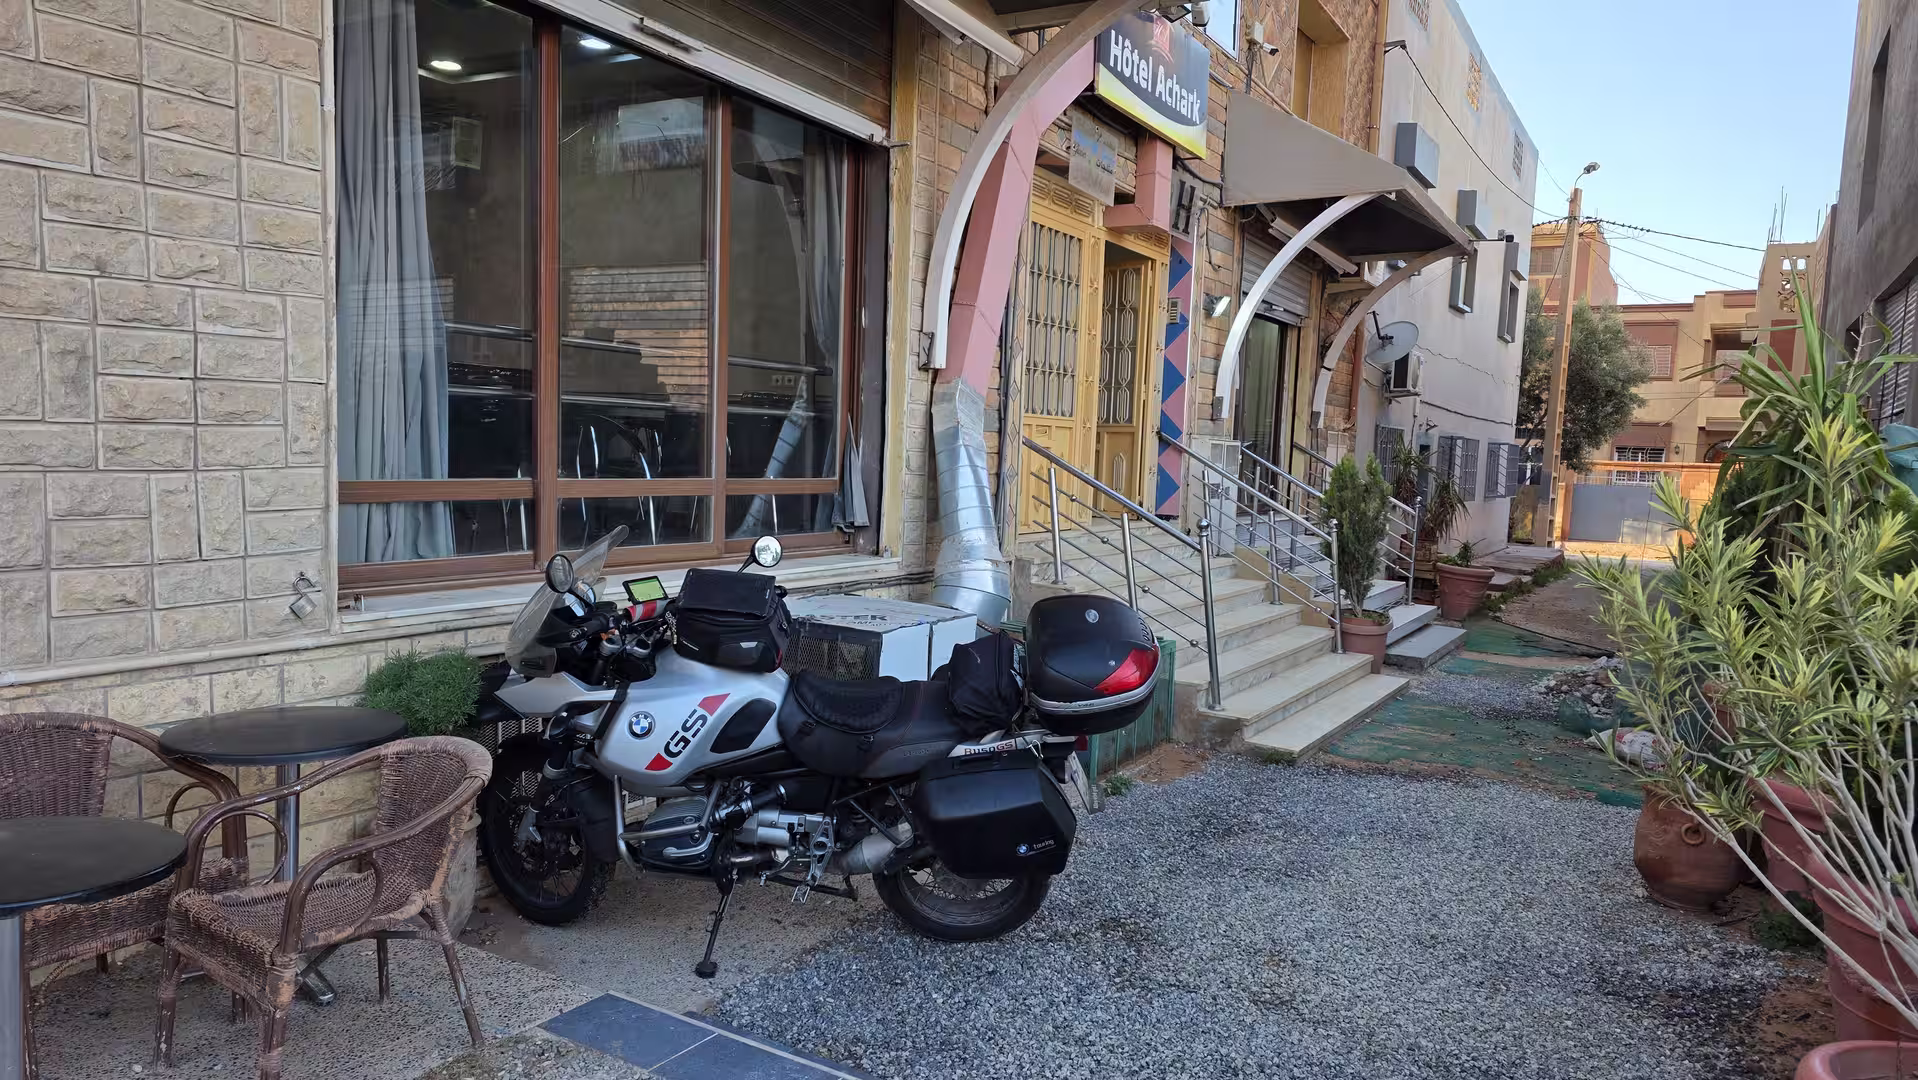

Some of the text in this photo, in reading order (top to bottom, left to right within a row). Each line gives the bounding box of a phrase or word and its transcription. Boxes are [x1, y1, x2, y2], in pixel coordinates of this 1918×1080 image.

[1109, 29, 1200, 124] Hôtel Achark
[1172, 179, 1196, 235] H
[664, 708, 708, 759] GS
